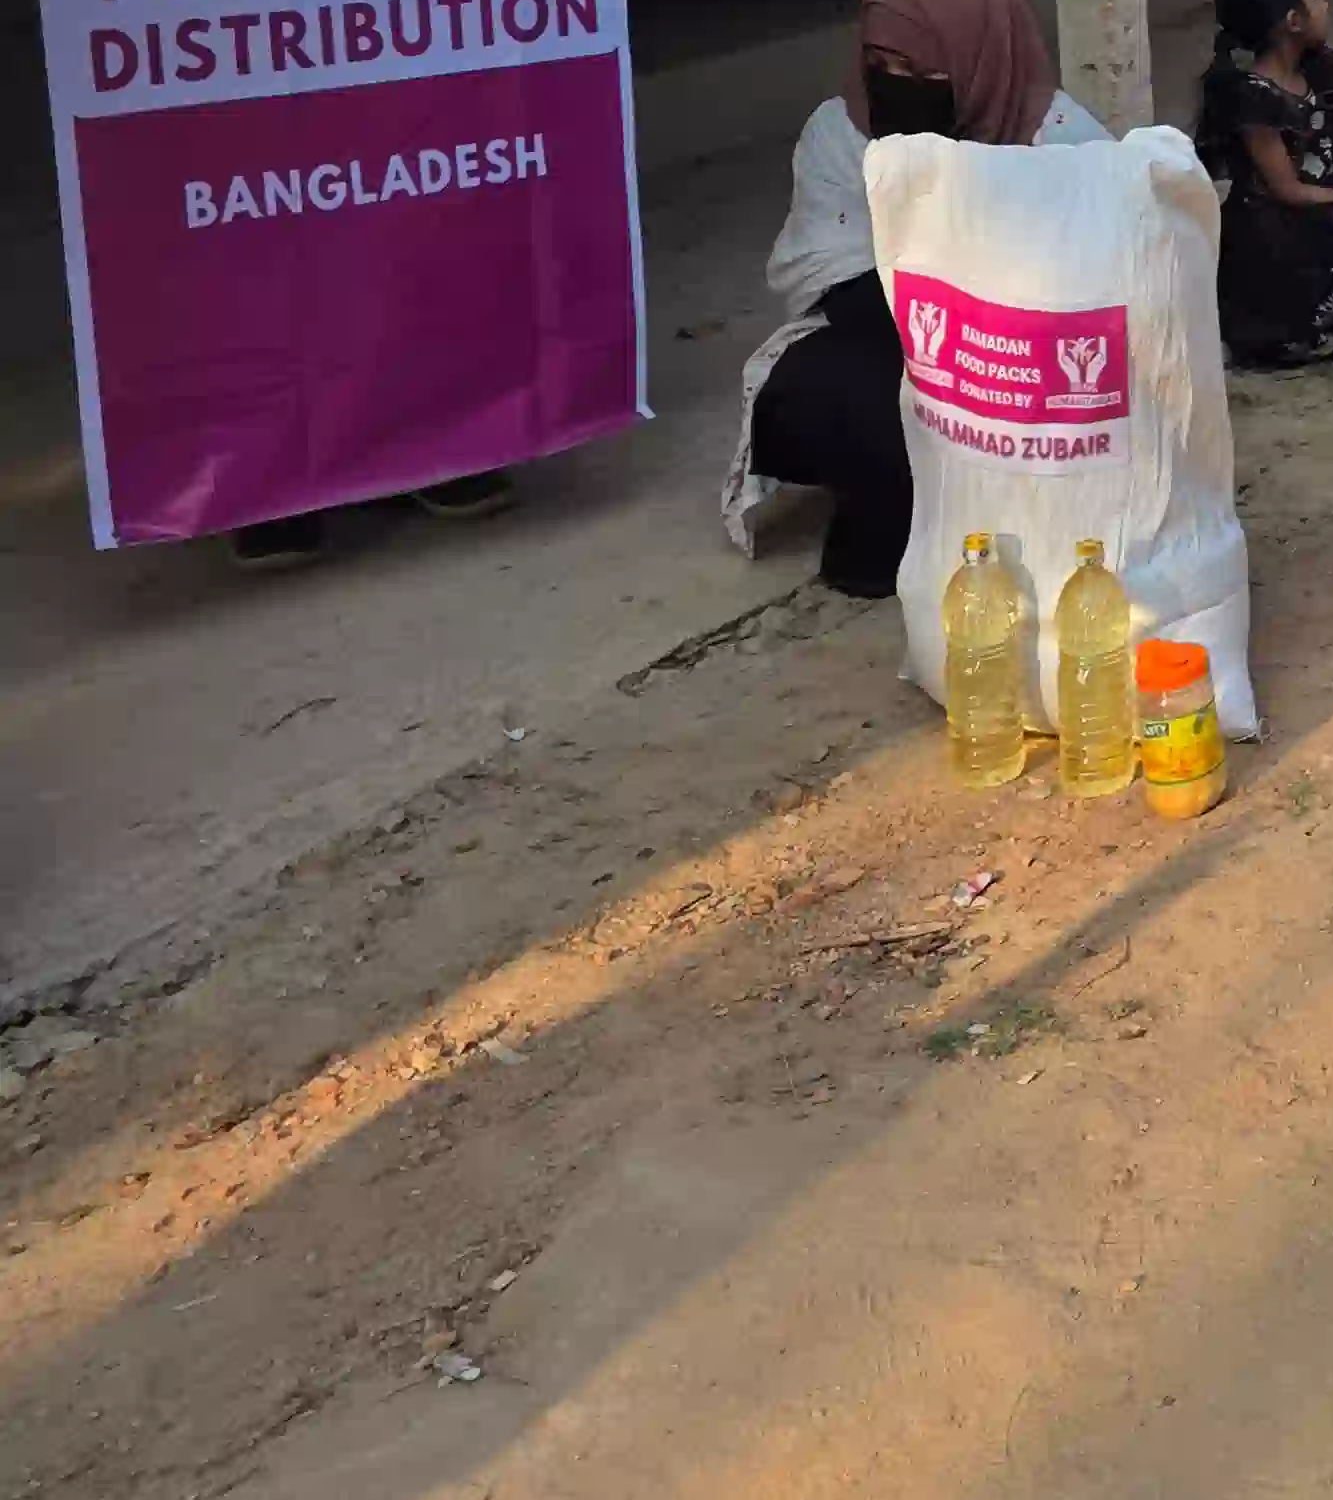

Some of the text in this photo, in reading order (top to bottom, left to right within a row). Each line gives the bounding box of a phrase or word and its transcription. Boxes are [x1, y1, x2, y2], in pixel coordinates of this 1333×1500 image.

[184, 133, 548, 229] BANGLADESH
[961, 324, 1033, 357] RAMADAN
[955, 350, 986, 376] FOOD
[988, 362, 1041, 384] PACKS
[959, 379, 1013, 406] DONATED
[1014, 393, 1034, 409] BY
[1020, 432, 1111, 461] ZUBAIR
